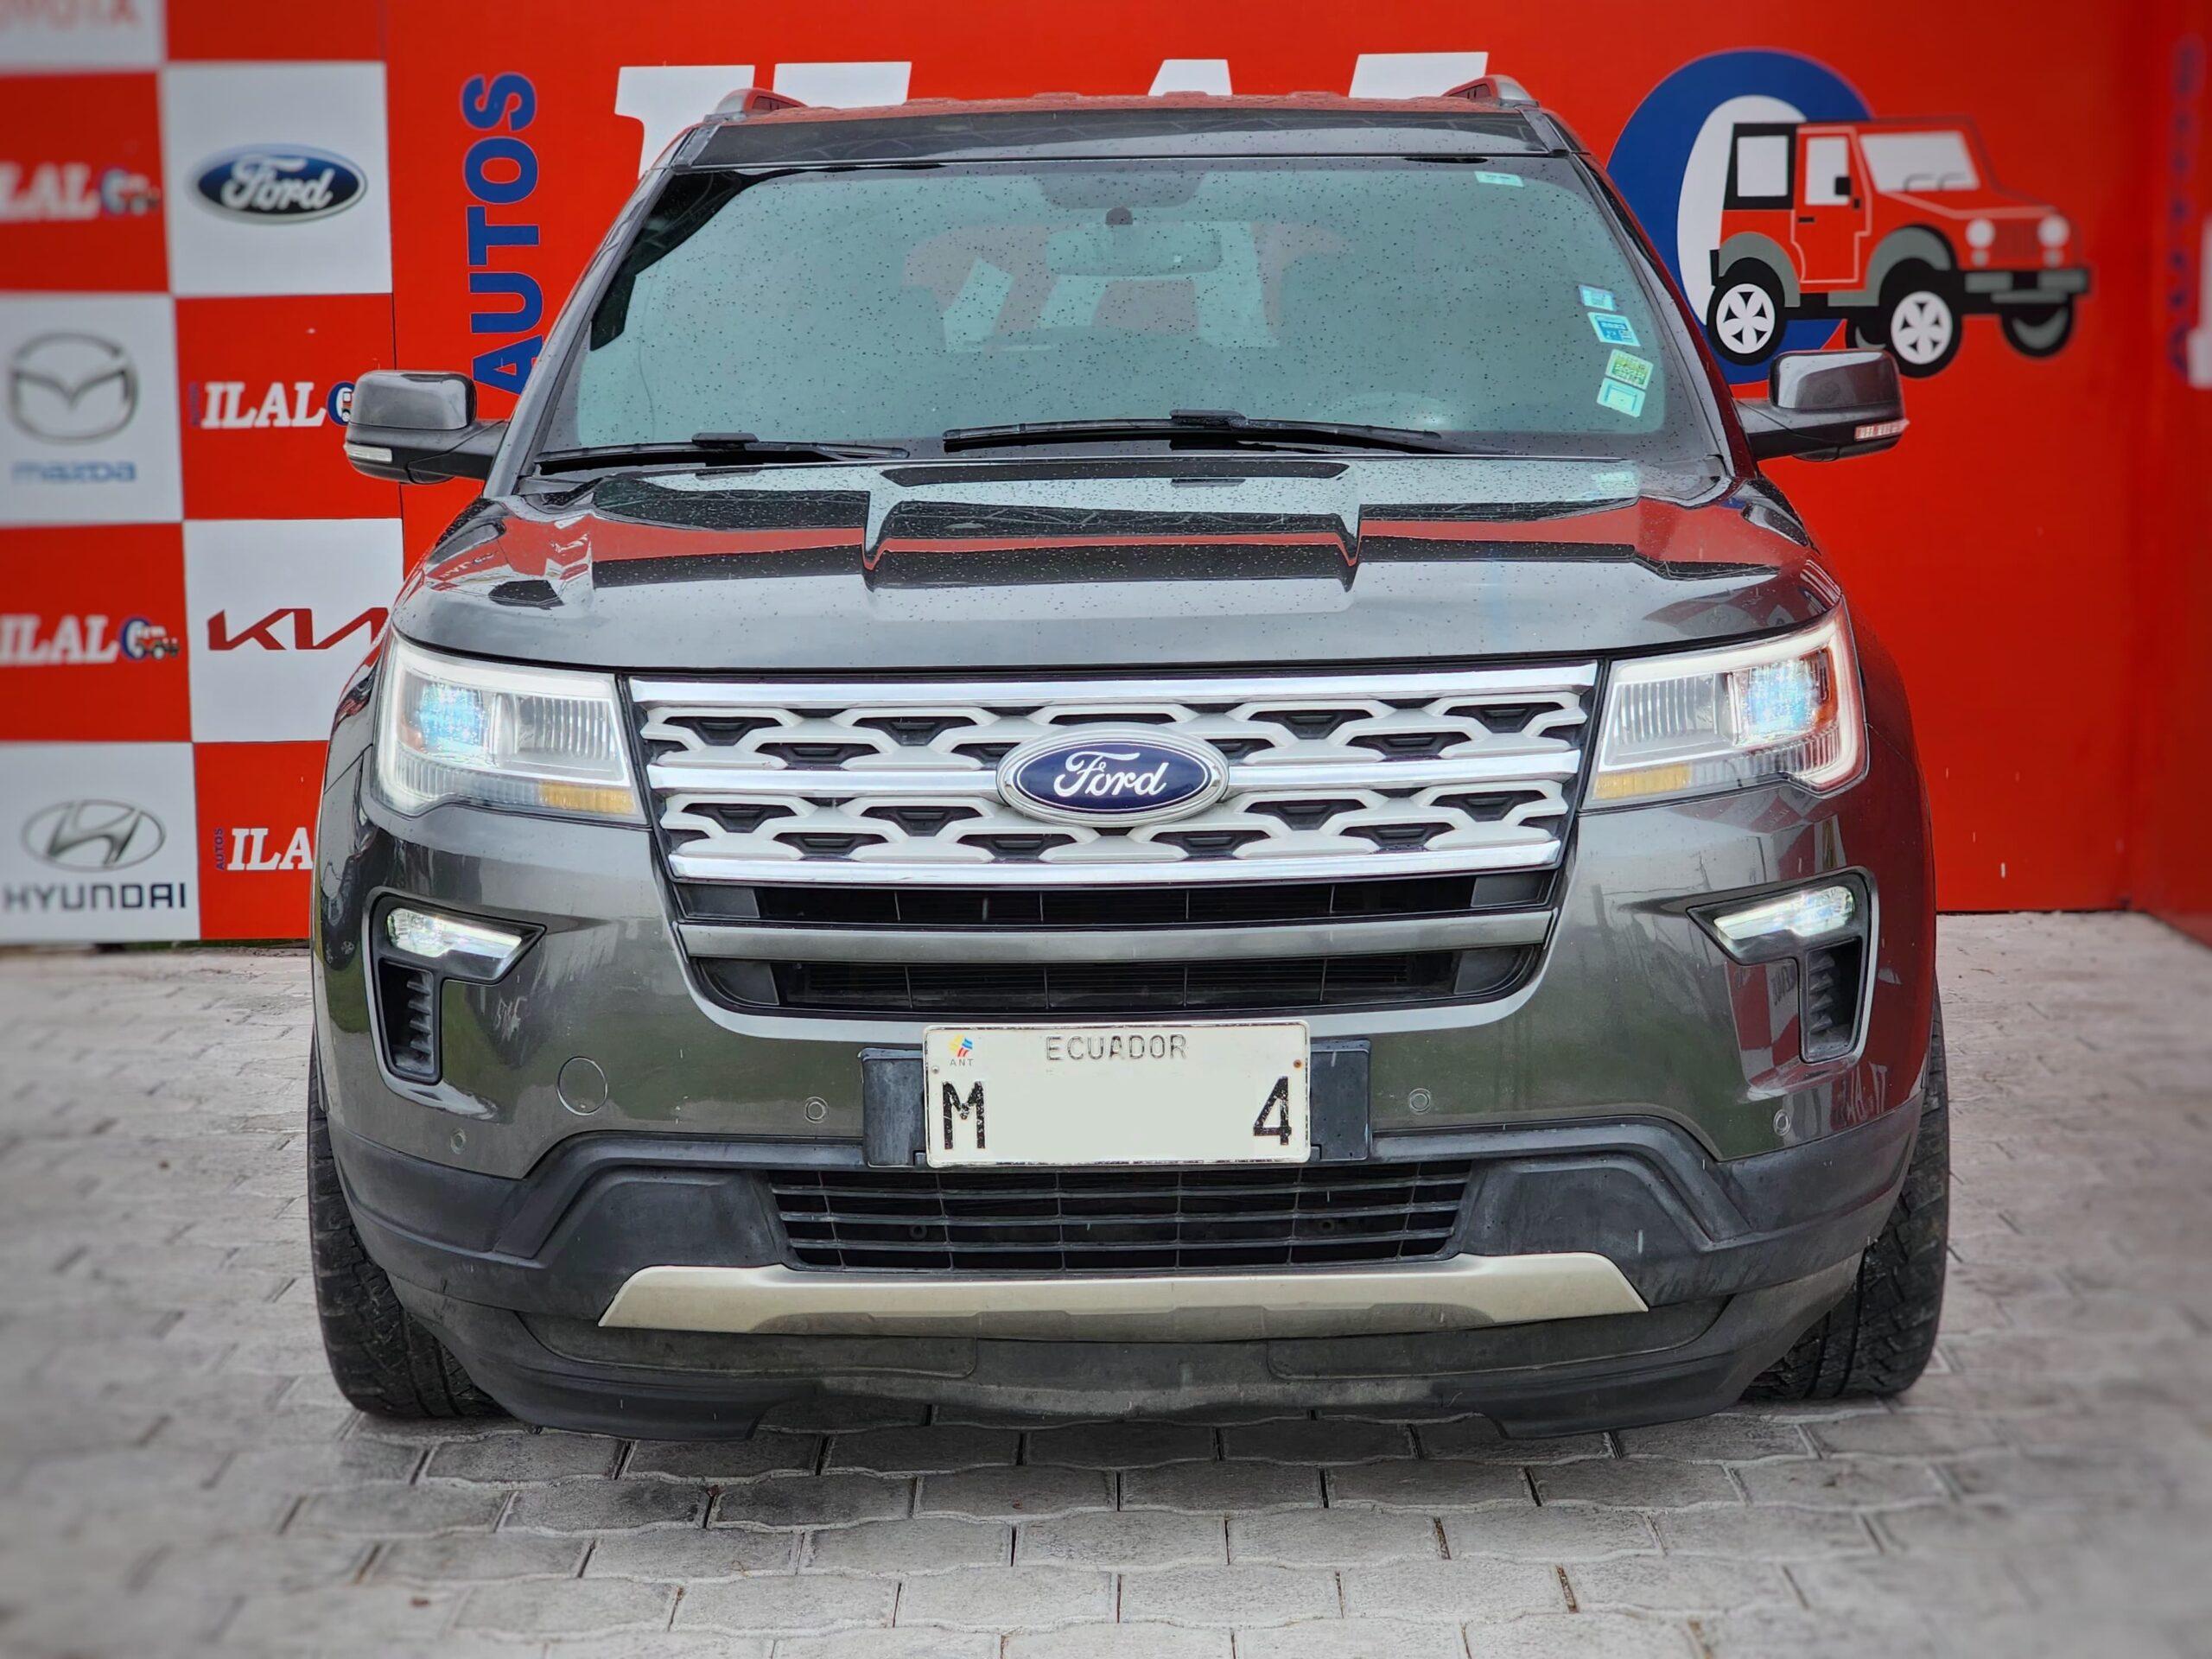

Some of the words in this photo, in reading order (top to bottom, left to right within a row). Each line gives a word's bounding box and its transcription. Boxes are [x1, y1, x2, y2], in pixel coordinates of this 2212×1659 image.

[220, 153, 337, 210] Ford
[461, 72, 543, 395] AUTOS
[1053, 751, 1170, 798] Ford
[3, 882, 186, 912] HYUNDAI
[950, 1058, 974, 1067] ANT
[1046, 1033, 1187, 1061] ECUADOR
[942, 1081, 986, 1150] M
[1253, 1076, 1293, 1147] 4
